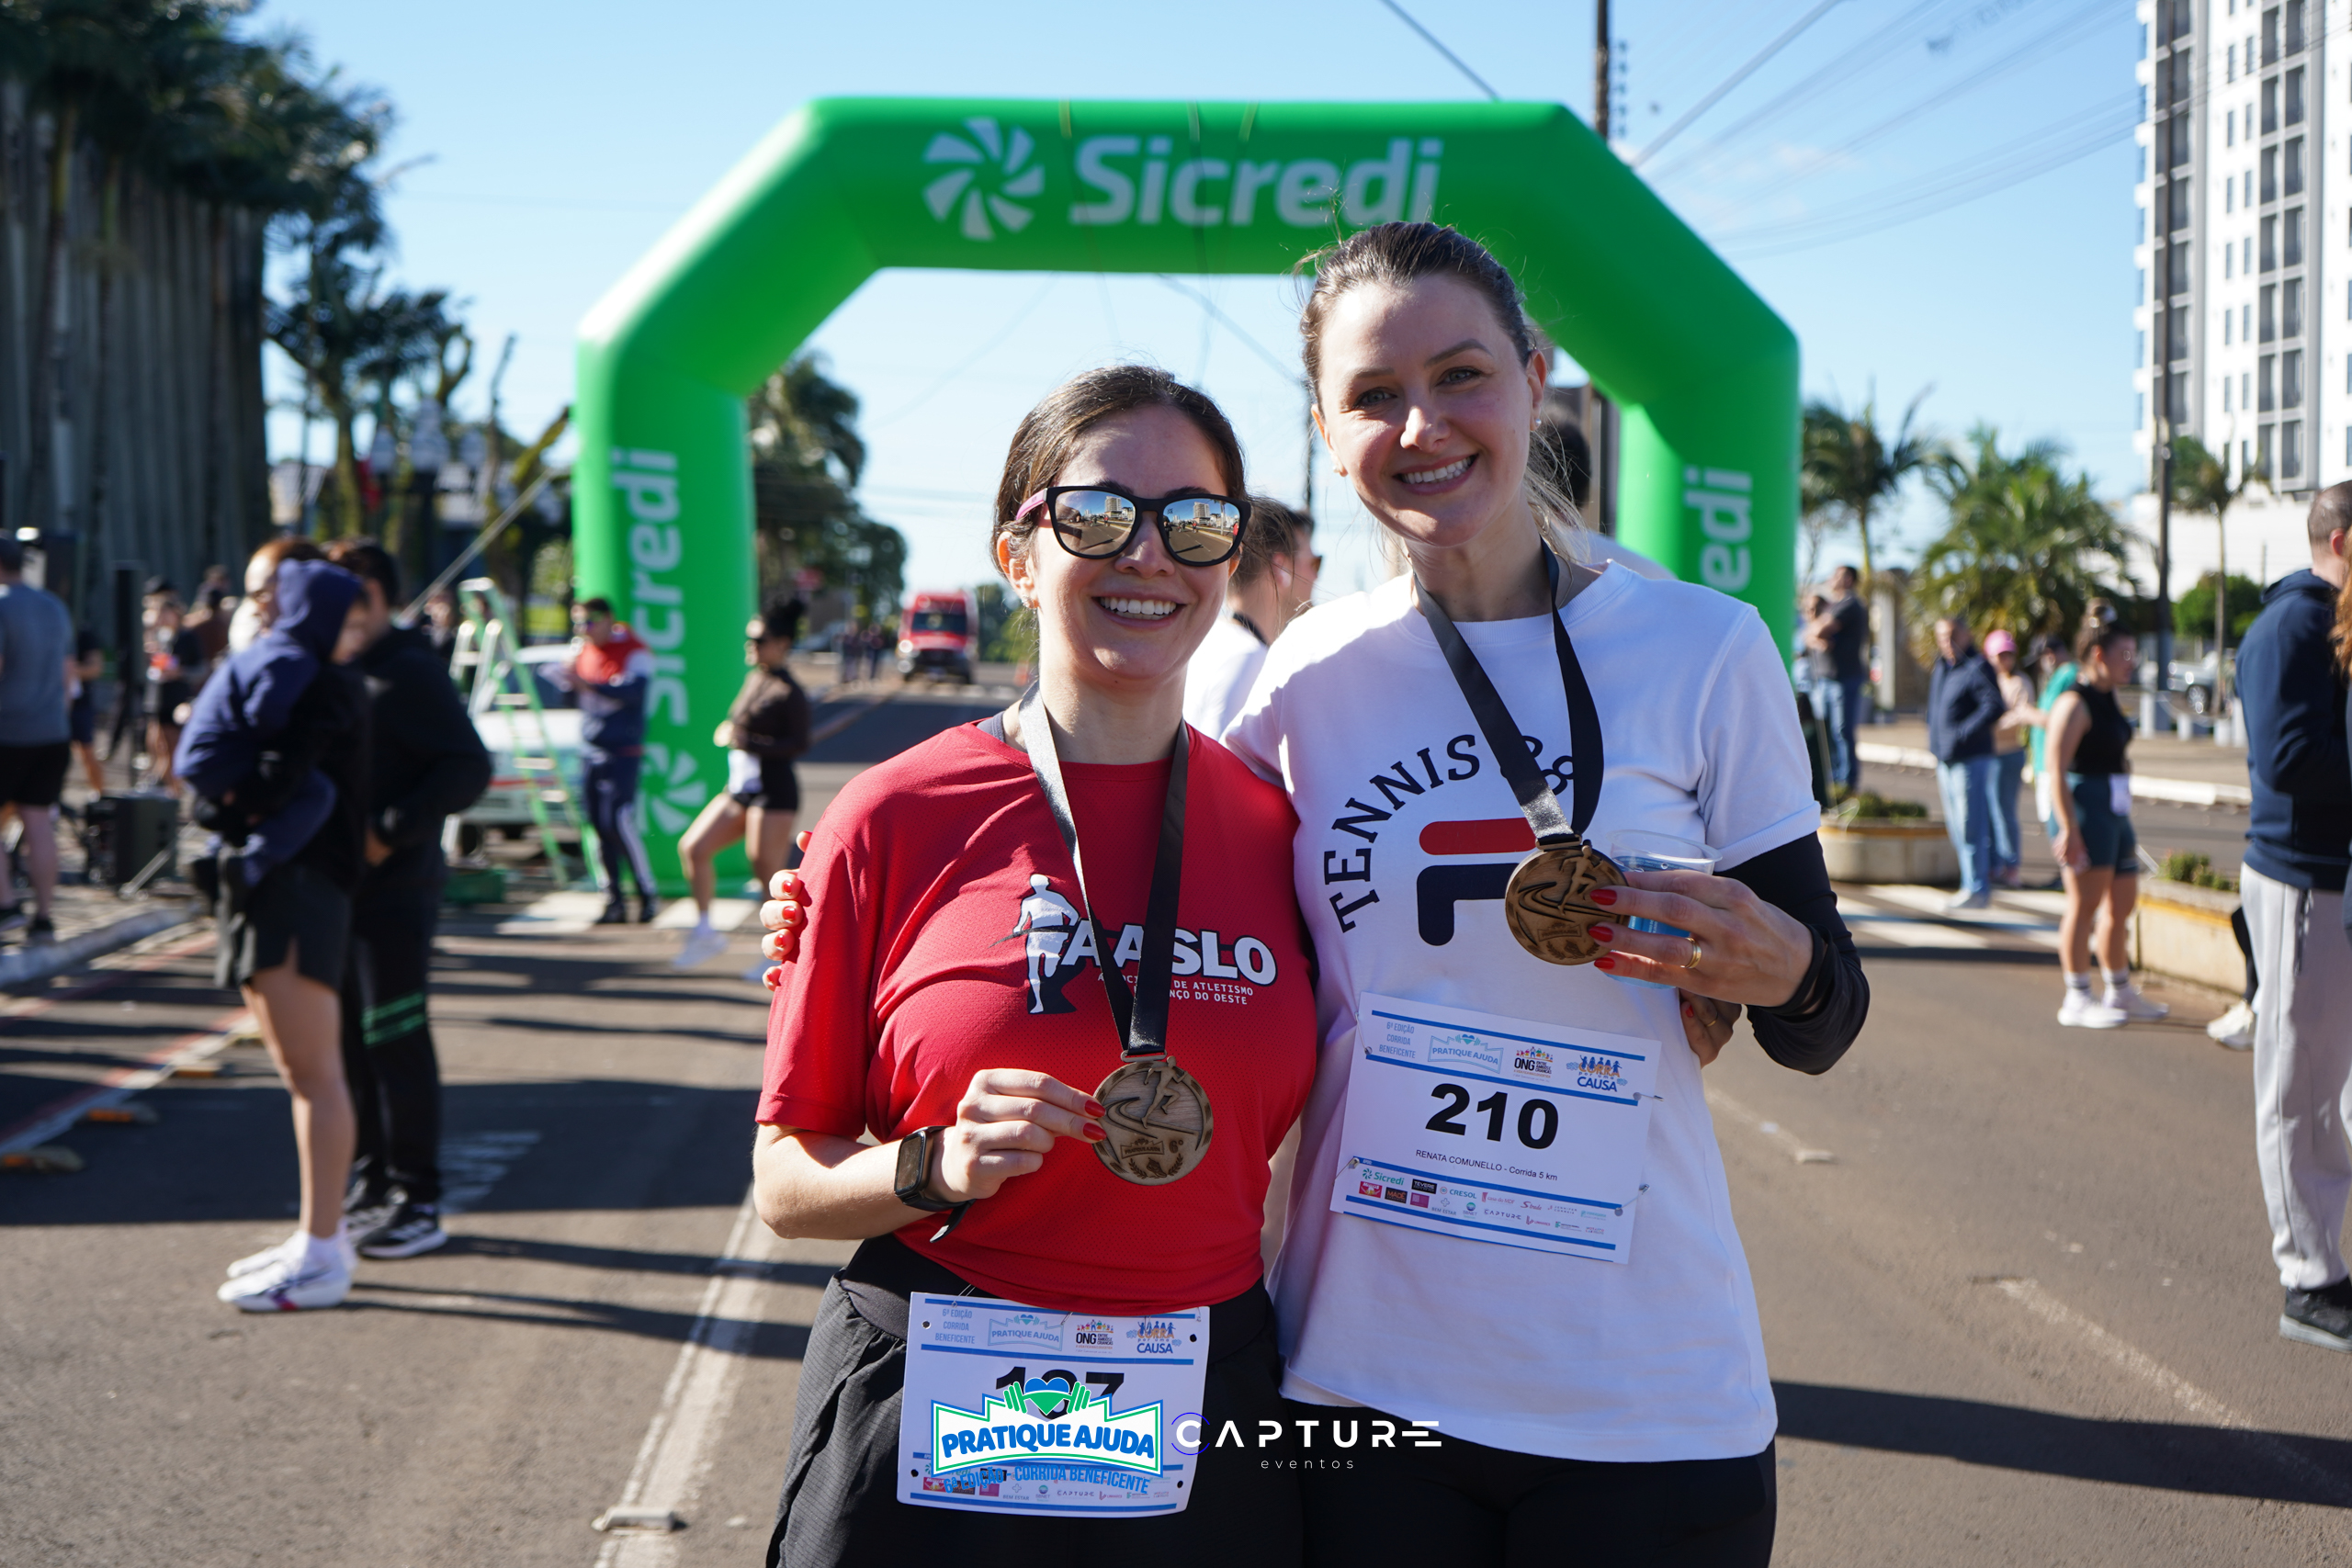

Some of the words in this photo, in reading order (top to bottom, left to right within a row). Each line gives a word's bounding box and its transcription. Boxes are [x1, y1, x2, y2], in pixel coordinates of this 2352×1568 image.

[1068, 134, 1444, 227] Sicredi
[1324, 734, 1480, 933] TENNIS
[1173, 979, 1187, 990] DE
[1193, 981, 1254, 997] ATLETISMO
[1194, 991, 1209, 1001] DO
[1214, 992, 1248, 1005] OESTE
[1394, 1022, 1415, 1034] EDIÇÃO
[1386, 1033, 1411, 1045] CORRIDA
[1378, 1044, 1417, 1059] BENEFICENTE
[1431, 1047, 1472, 1057] PRATIQUE
[1473, 1052, 1499, 1066] AJUDA
[1514, 1057, 1535, 1071] ONG
[1577, 1076, 1618, 1092] CAUSA
[1425, 1083, 1559, 1150] 210
[1415, 1149, 1447, 1163] RENATA
[1448, 1156, 1503, 1172] COMUNELLO
[1509, 1166, 1537, 1179] Corrida
[1538, 1171, 1545, 1179] 5
[1545, 1172, 1558, 1181] km
[1374, 1171, 1405, 1186] Sicredi
[1449, 1189, 1477, 1200] CRESOL
[1484, 1209, 1521, 1220] CAPTURE
[950, 1309, 972, 1320] EDIÇÃO
[943, 1321, 969, 1331] CORRIDA
[935, 1333, 976, 1344] BENEFICENTE
[991, 1329, 1032, 1338] PRATIQUE
[1033, 1332, 1059, 1342] AJUDA
[1076, 1332, 1097, 1345] ONG
[1136, 1342, 1173, 1354] CAUSA
